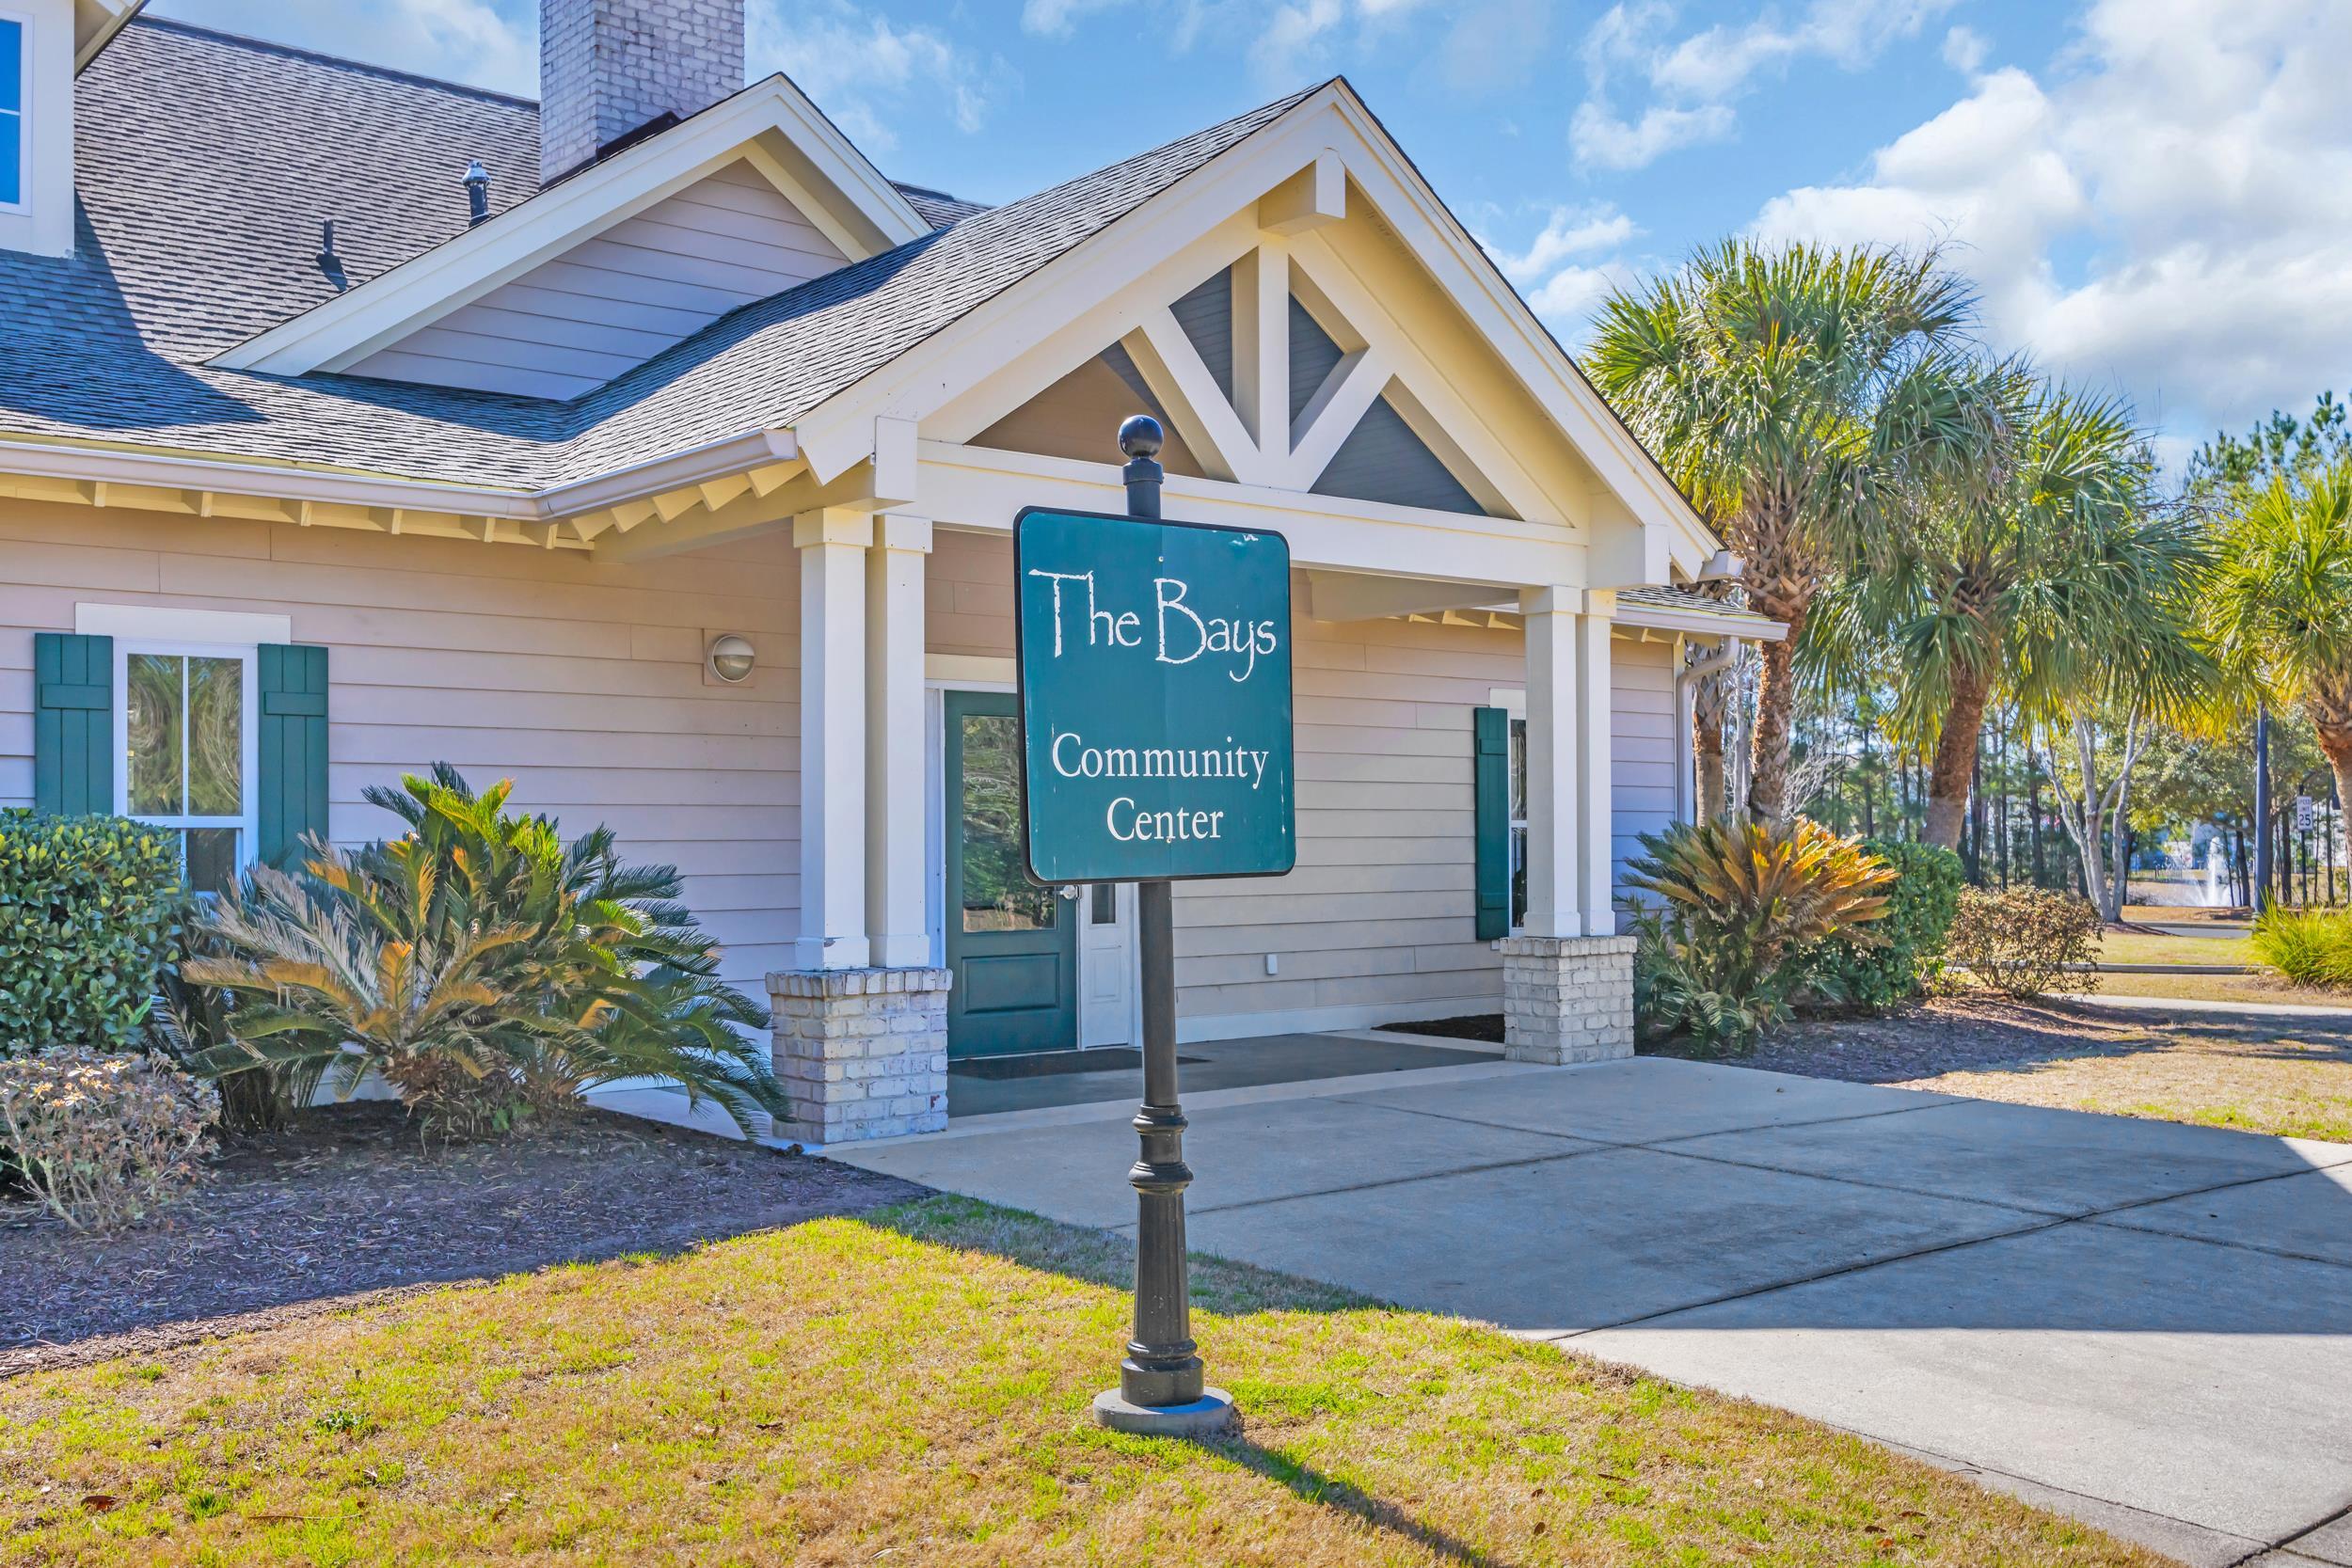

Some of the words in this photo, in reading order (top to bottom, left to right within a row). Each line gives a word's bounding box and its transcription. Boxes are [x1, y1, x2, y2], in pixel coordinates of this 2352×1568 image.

[1028, 568, 1142, 658] The
[1153, 578, 1278, 683] Bays
[1052, 733, 1270, 789] Community
[1106, 797, 1225, 842] Center
[2298, 814, 2312, 827] 25
